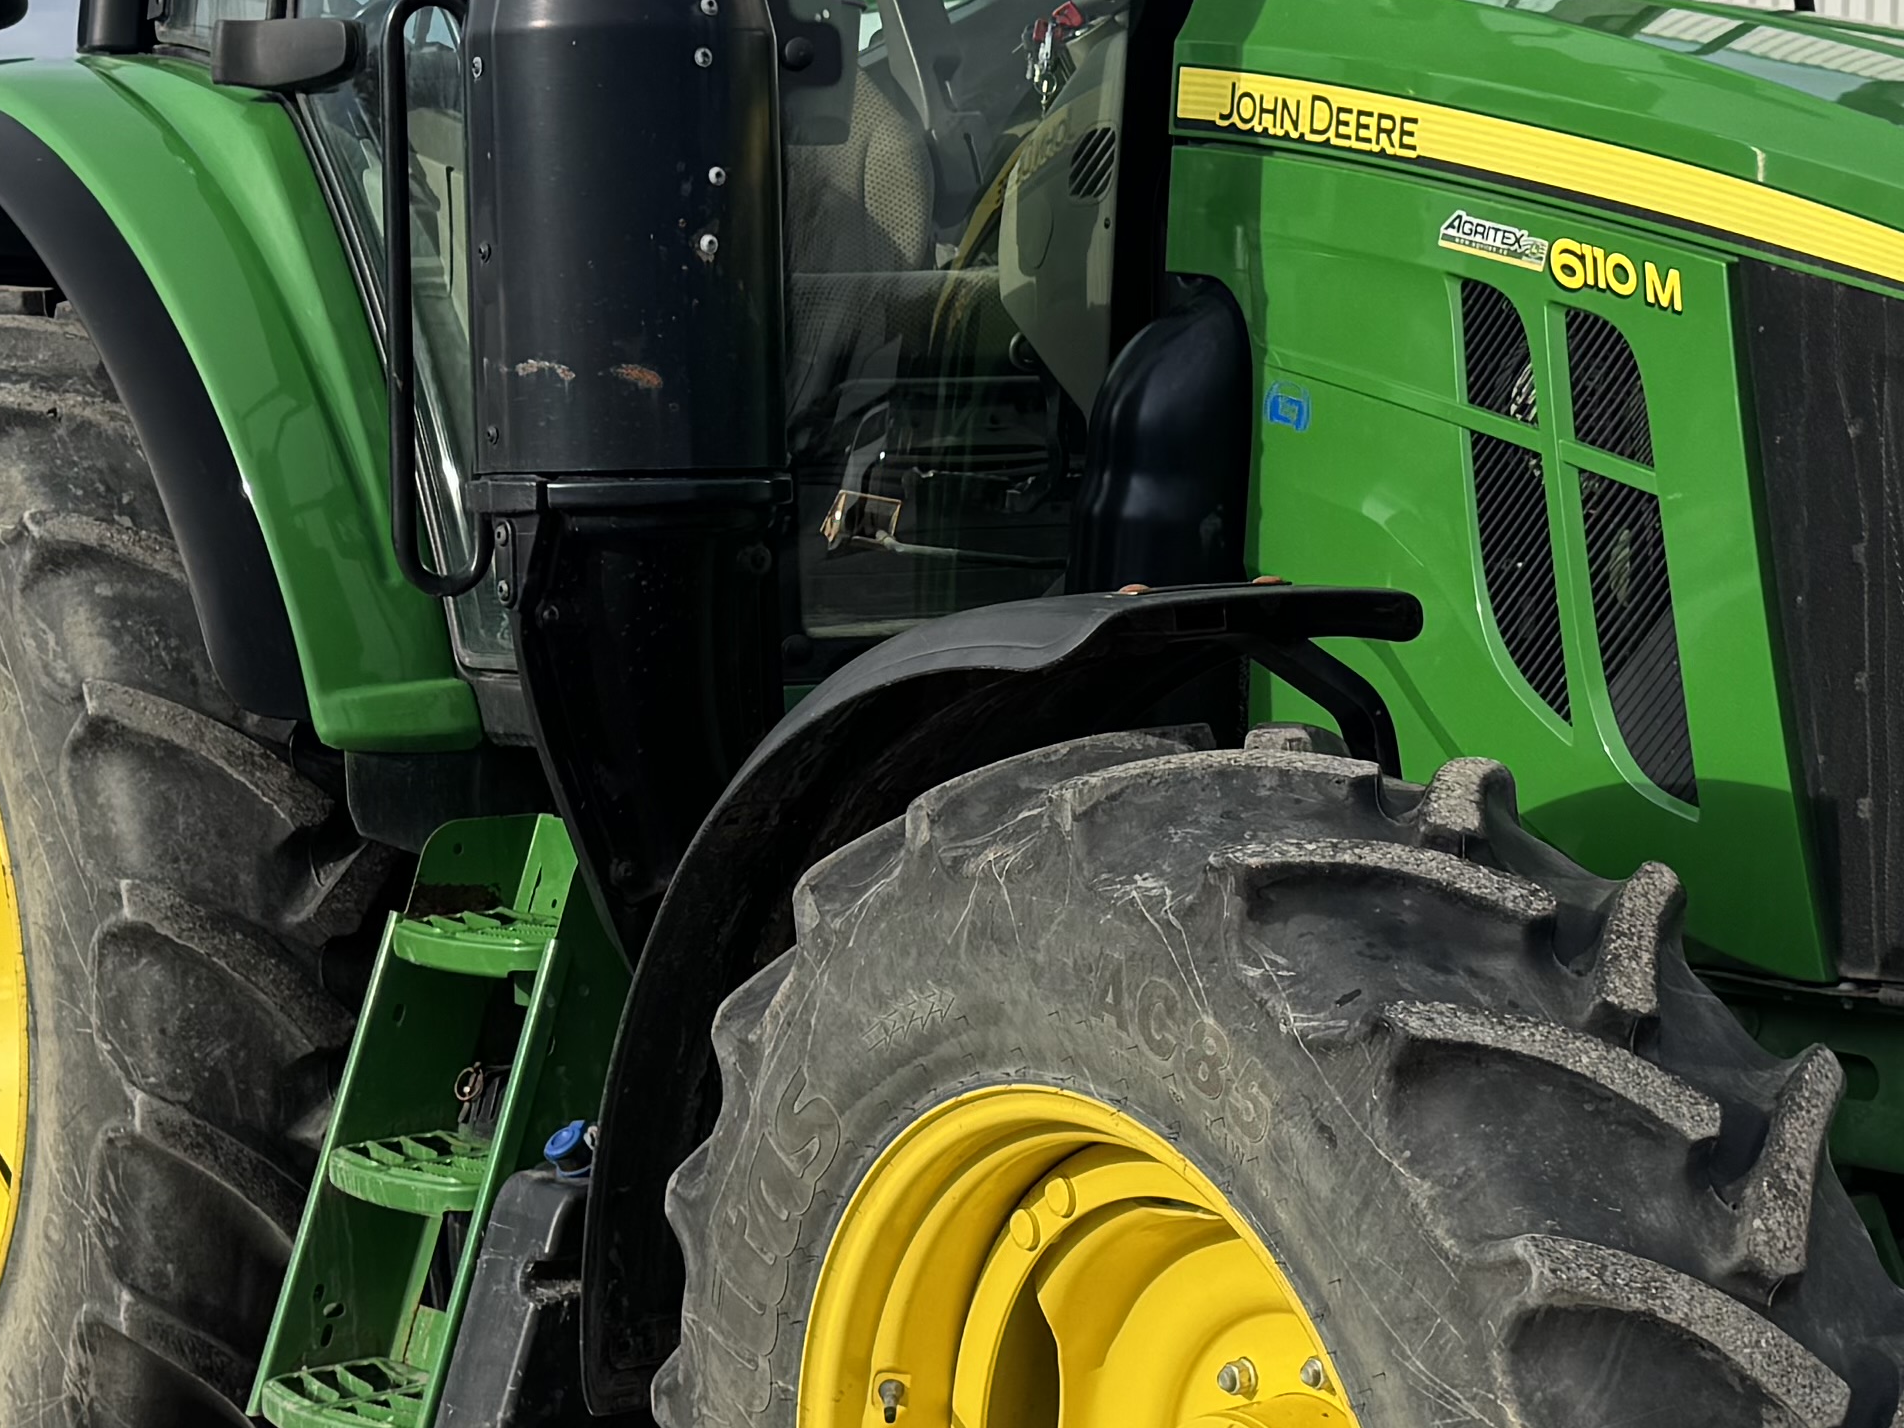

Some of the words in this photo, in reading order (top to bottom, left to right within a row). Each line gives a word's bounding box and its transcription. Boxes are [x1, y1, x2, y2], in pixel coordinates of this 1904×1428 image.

[1218, 81, 1301, 133] JOHN
[1308, 94, 1420, 152] DEERE
[1443, 214, 1525, 250] AGRITEX
[1550, 237, 1638, 297] 6110
[1644, 261, 1684, 313] M
[1092, 950, 1274, 1145] AC85
